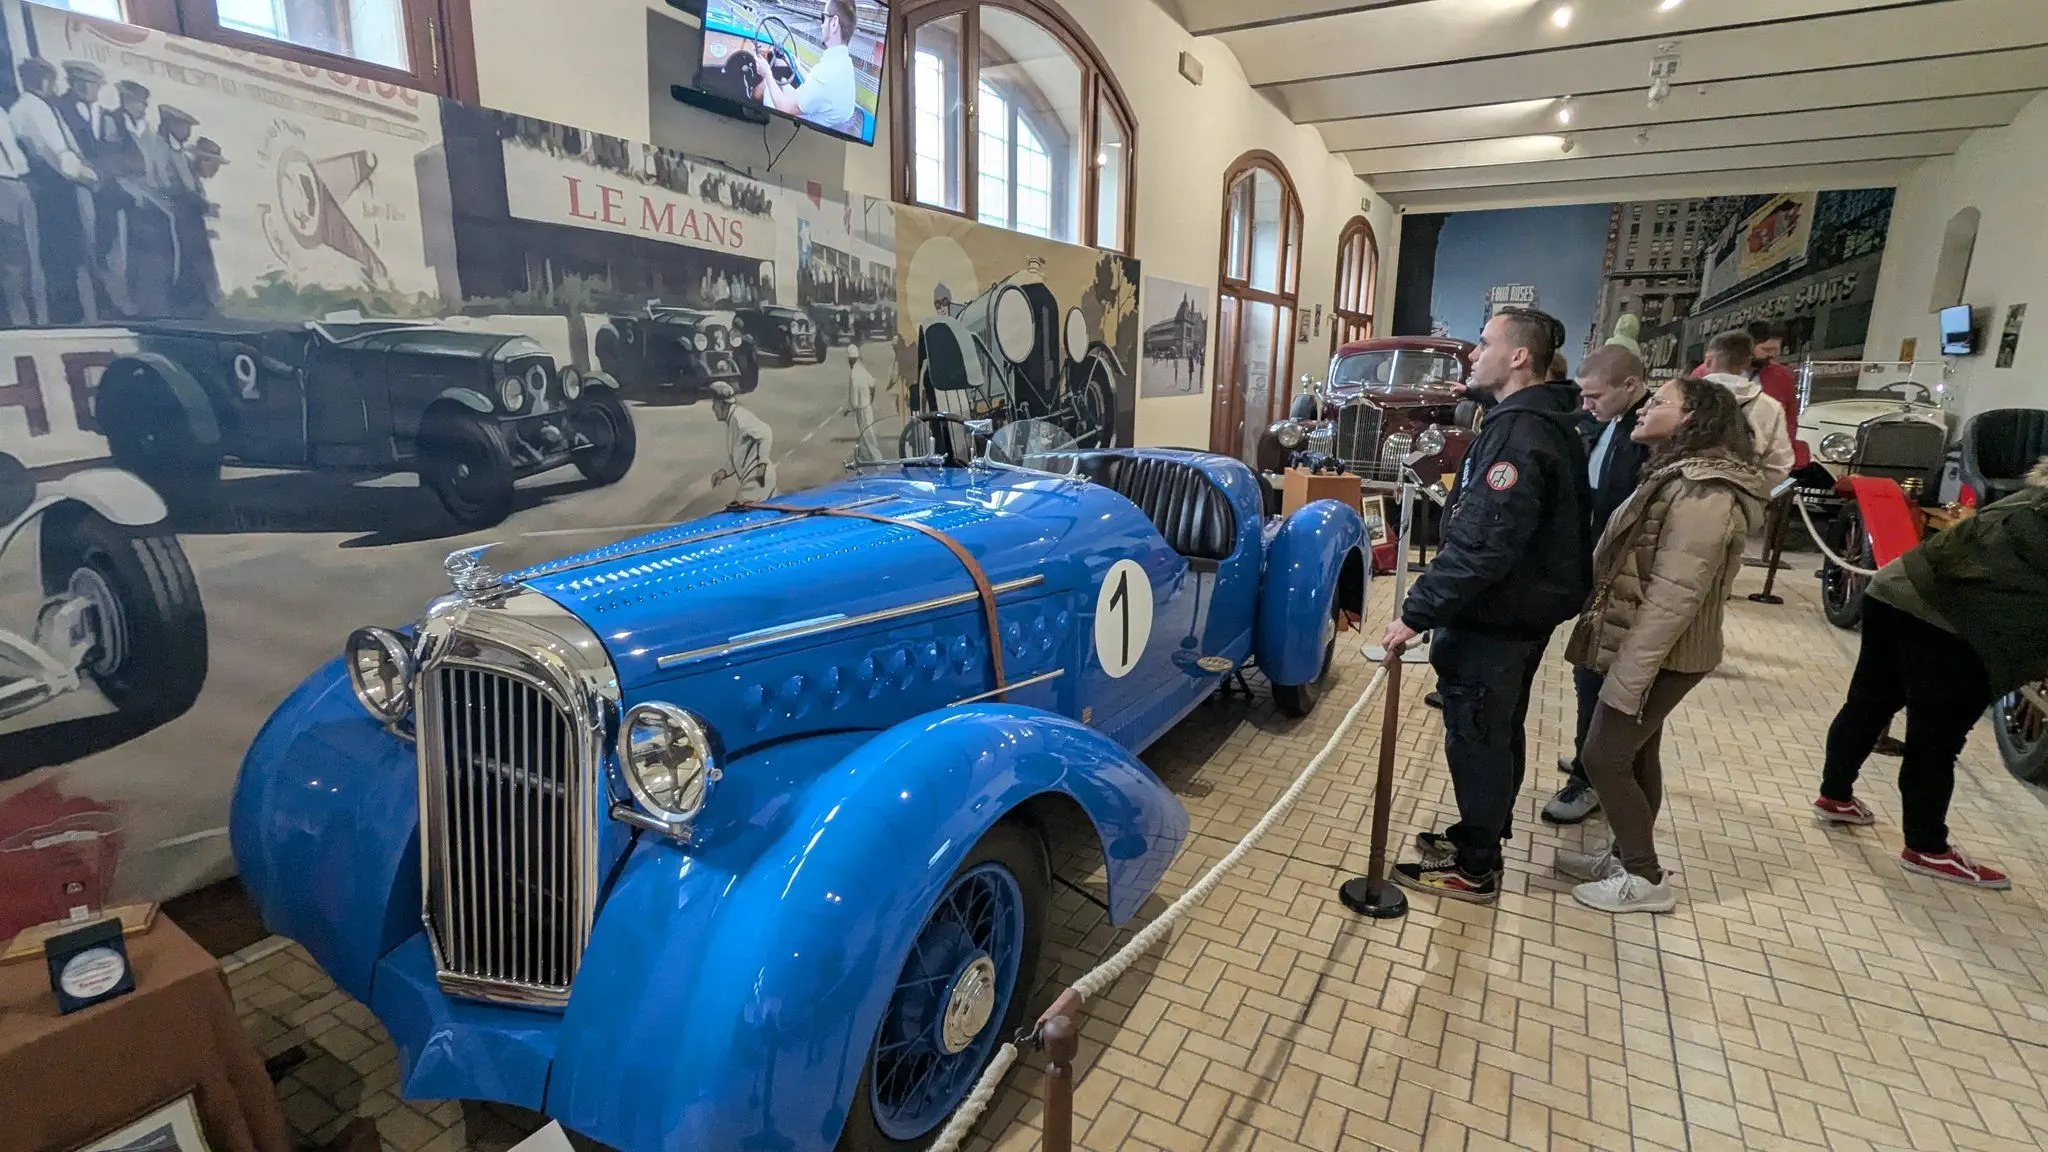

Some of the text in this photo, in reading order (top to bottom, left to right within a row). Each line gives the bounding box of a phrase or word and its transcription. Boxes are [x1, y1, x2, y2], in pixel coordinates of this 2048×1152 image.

[562, 175, 744, 249] LE MANS
[1490, 285, 1535, 302] FOUR ROSES
[1795, 272, 1859, 308] SUITS
[713, 330, 726, 352] 3
[234, 354, 261, 400] 9
[1109, 569, 1130, 668] 1
